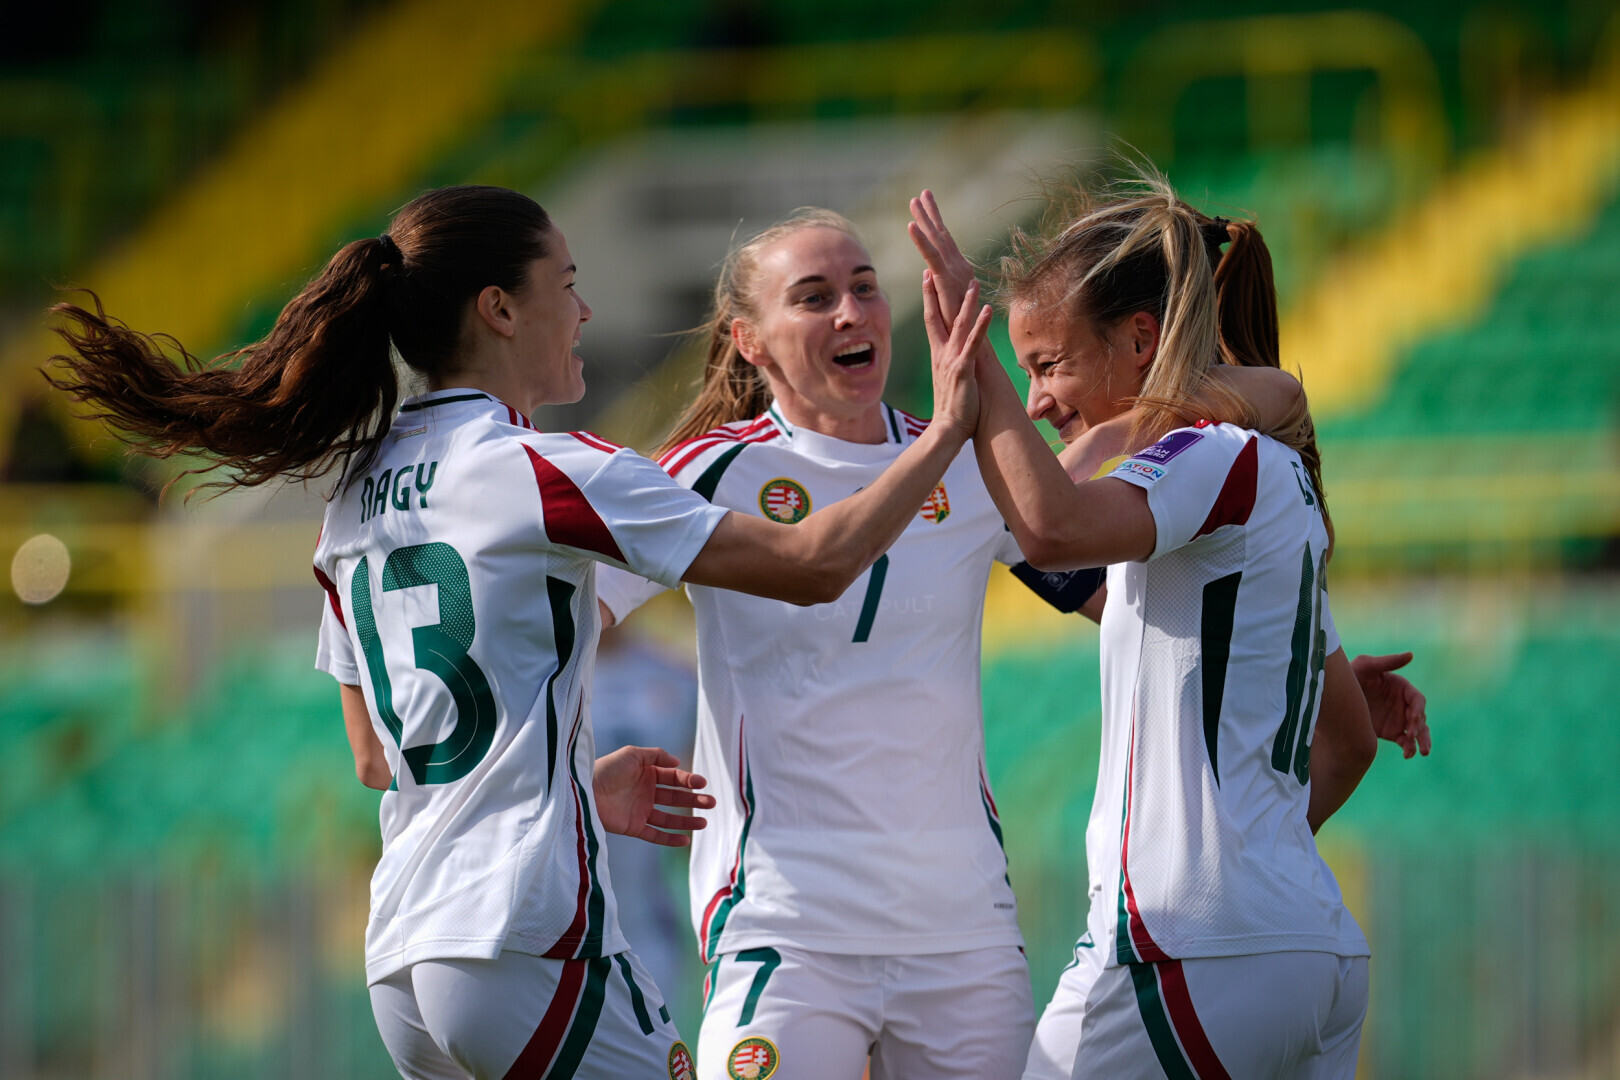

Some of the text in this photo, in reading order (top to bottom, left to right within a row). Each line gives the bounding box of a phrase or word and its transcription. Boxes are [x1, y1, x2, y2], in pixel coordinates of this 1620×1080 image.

[360, 461, 438, 524] NAGY
[814, 594, 936, 622] CATPULT
[351, 541, 497, 791] 13
[734, 946, 782, 1028] 7
